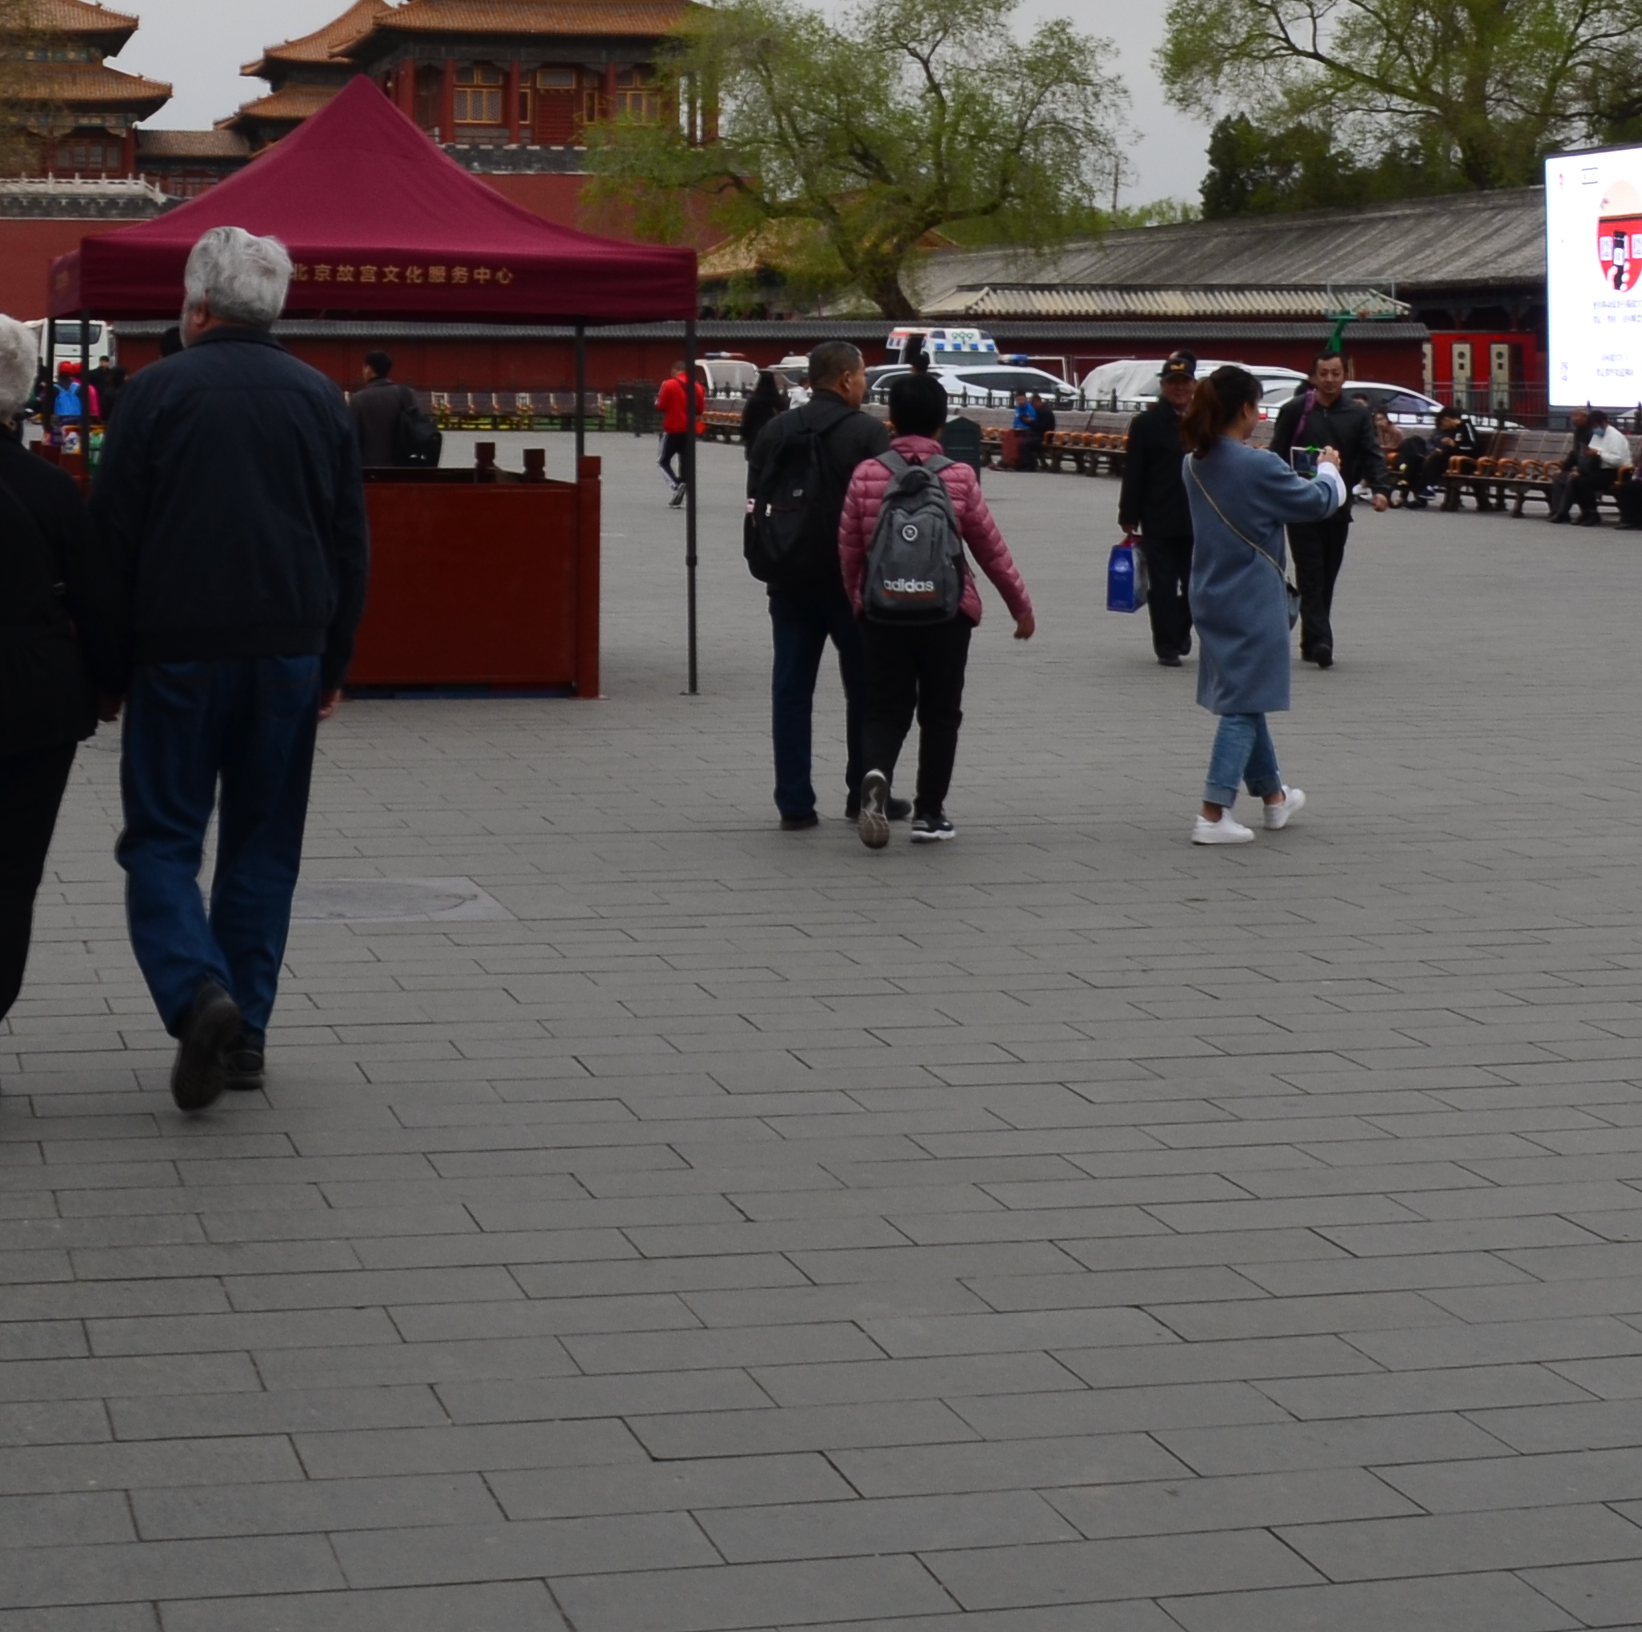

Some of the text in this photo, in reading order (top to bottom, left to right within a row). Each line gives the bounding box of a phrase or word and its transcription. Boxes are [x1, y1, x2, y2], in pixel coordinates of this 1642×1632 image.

[291, 263, 513, 284] 北京故宫文化服务中心
[883, 578, 934, 593] adidas
